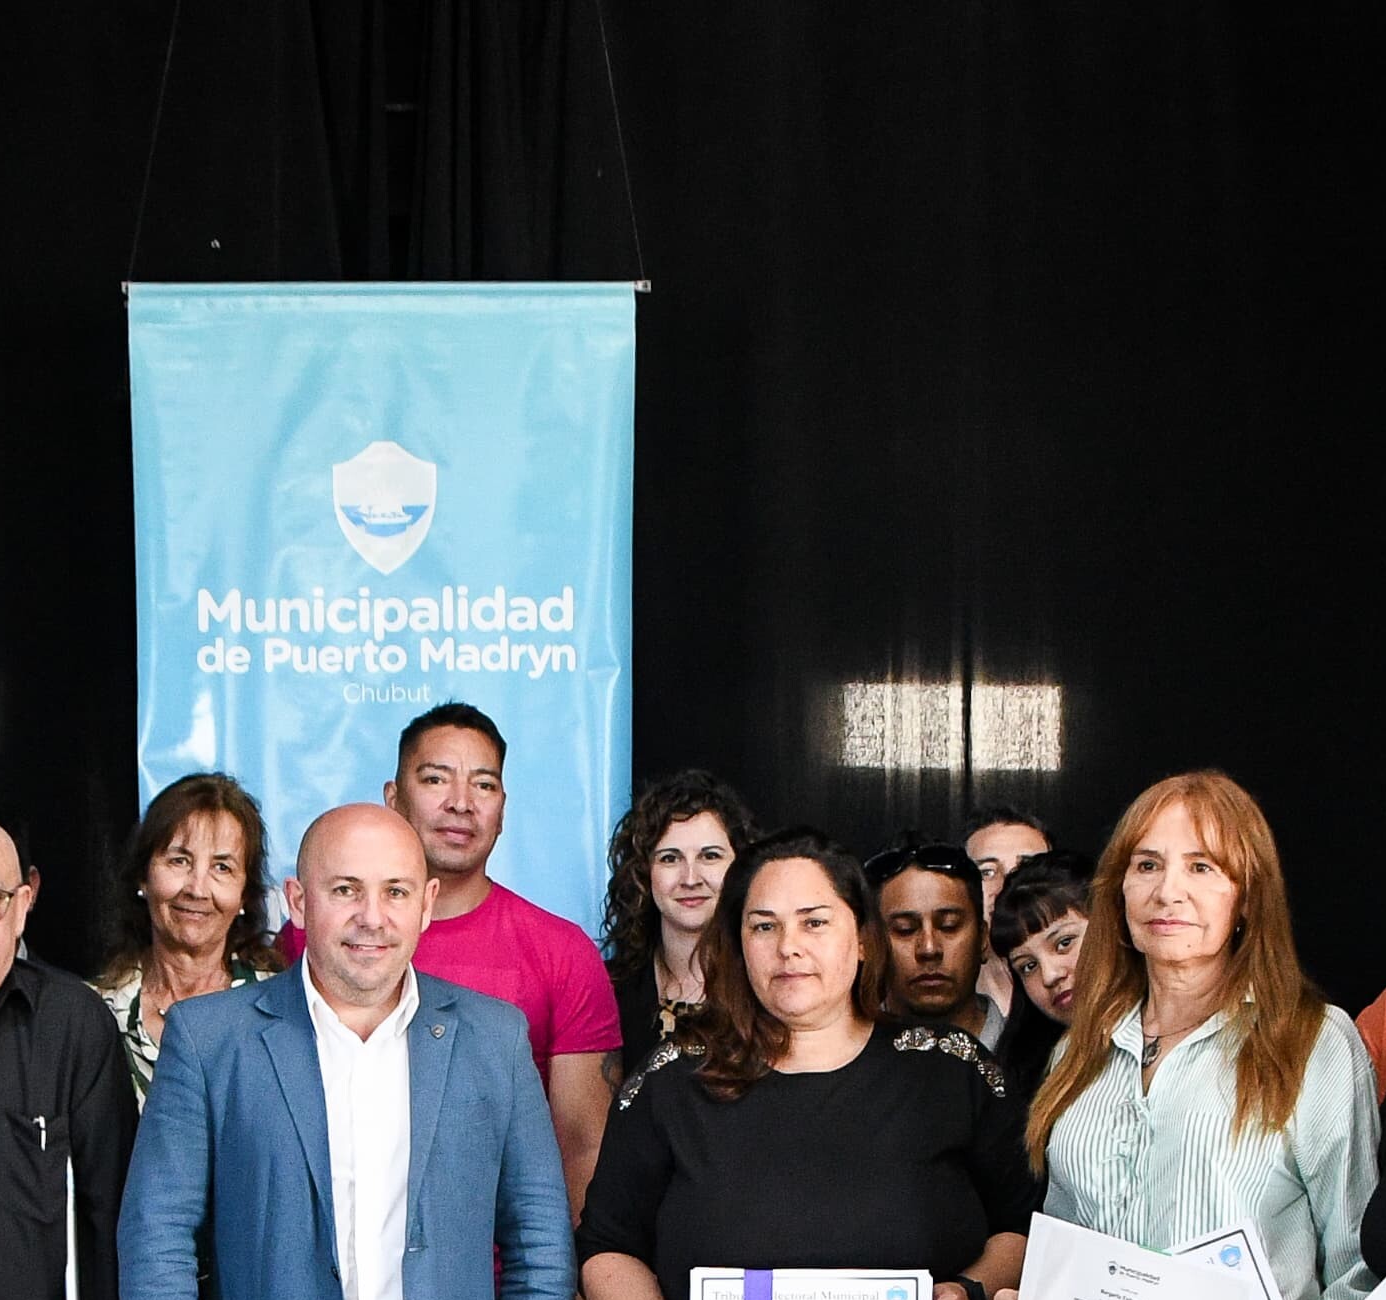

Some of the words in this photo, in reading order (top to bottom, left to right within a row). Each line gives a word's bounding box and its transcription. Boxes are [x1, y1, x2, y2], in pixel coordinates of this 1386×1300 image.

[196, 585, 575, 641] Municipalidad
[196, 637, 252, 674] de
[264, 639, 408, 674] Puerto
[419, 636, 577, 679] Madryn
[342, 682, 431, 705] Chubut
[774, 1290, 817, 1300] lectoral
